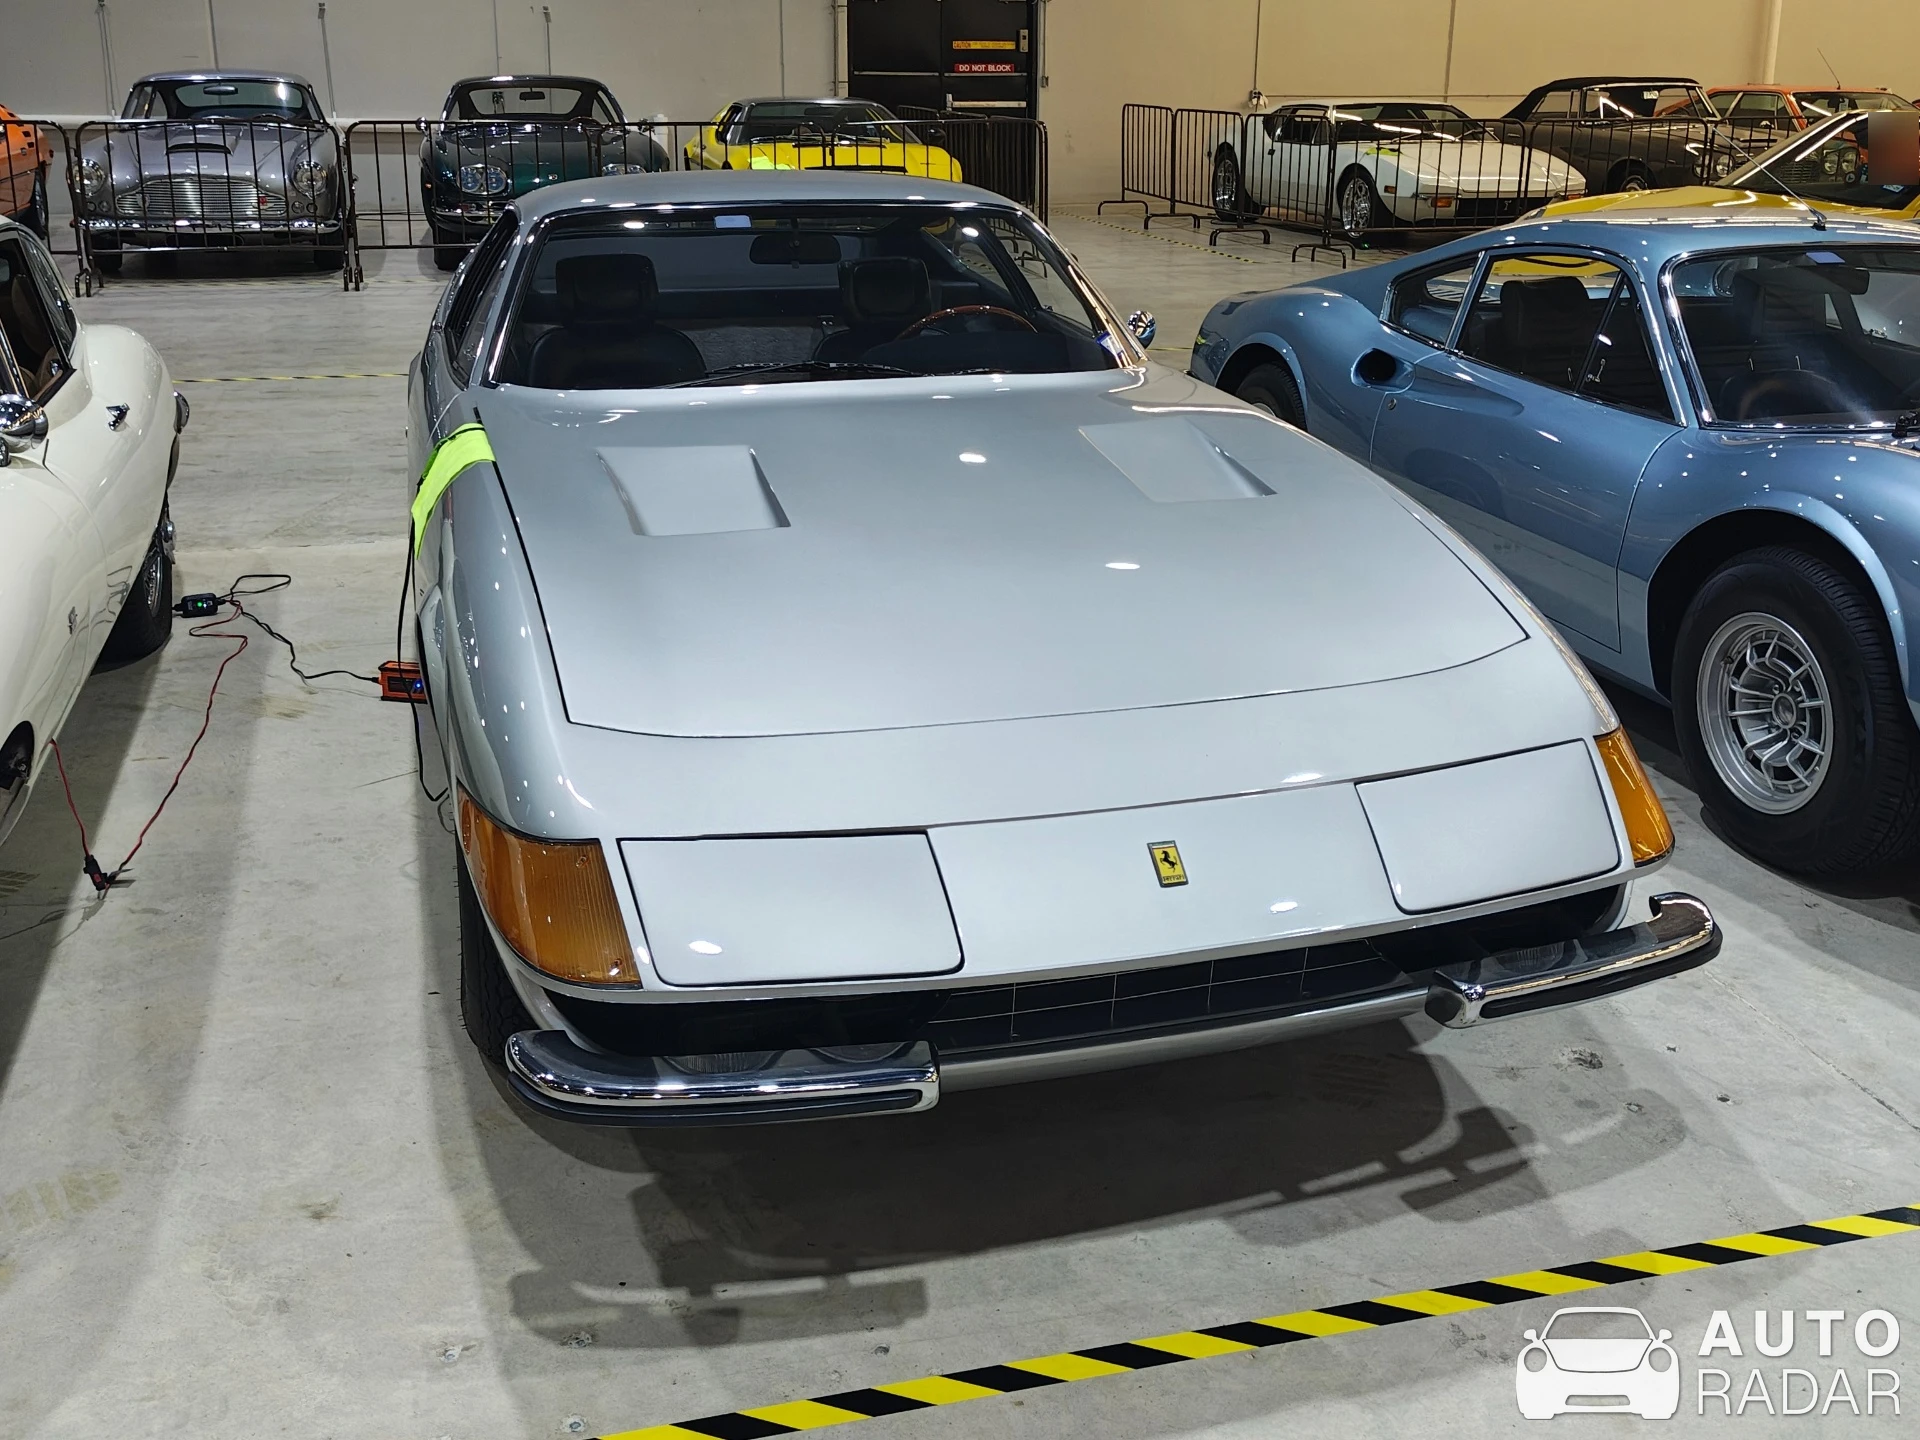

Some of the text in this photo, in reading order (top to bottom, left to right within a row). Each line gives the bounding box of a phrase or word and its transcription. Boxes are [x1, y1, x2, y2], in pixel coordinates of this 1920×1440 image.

[959, 64, 1011, 72] DO NOT BLOCK
